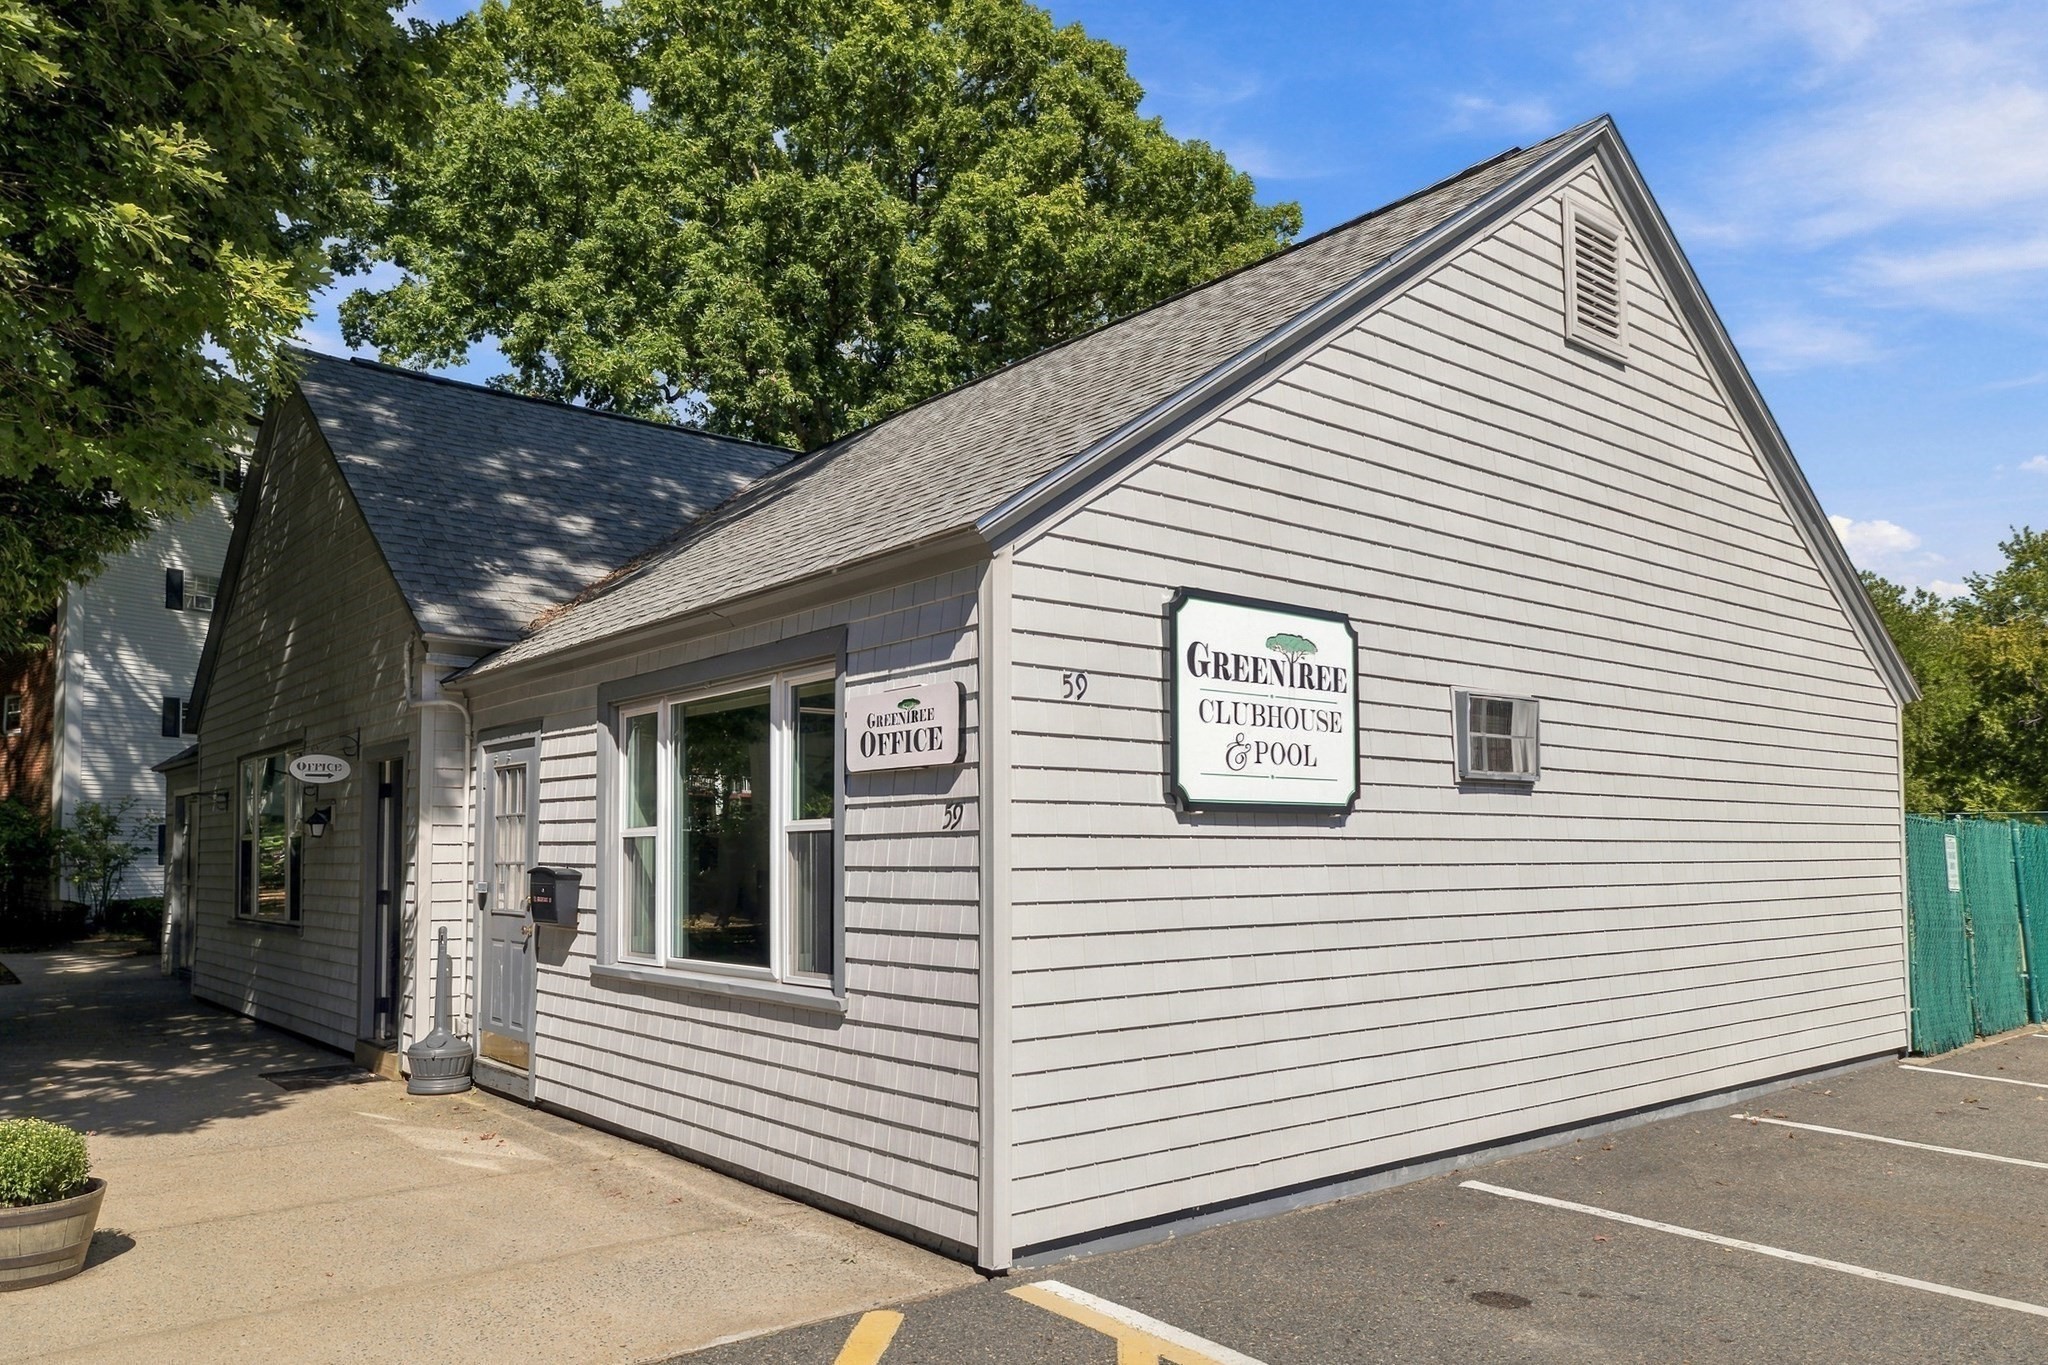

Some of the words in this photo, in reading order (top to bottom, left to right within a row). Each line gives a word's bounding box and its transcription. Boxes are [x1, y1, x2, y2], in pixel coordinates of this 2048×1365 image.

[1186, 641, 1347, 694] GREENTREE
[1062, 672, 1088, 701] 59
[866, 707, 935, 729] GREENTREE
[1198, 698, 1343, 734] CLUBHOUSE
[860, 726, 943, 758] OFFICE
[1225, 732, 1252, 771] &
[1253, 740, 1318, 768] POOL
[296, 762, 343, 772] OFFICE
[941, 802, 964, 831] 59
